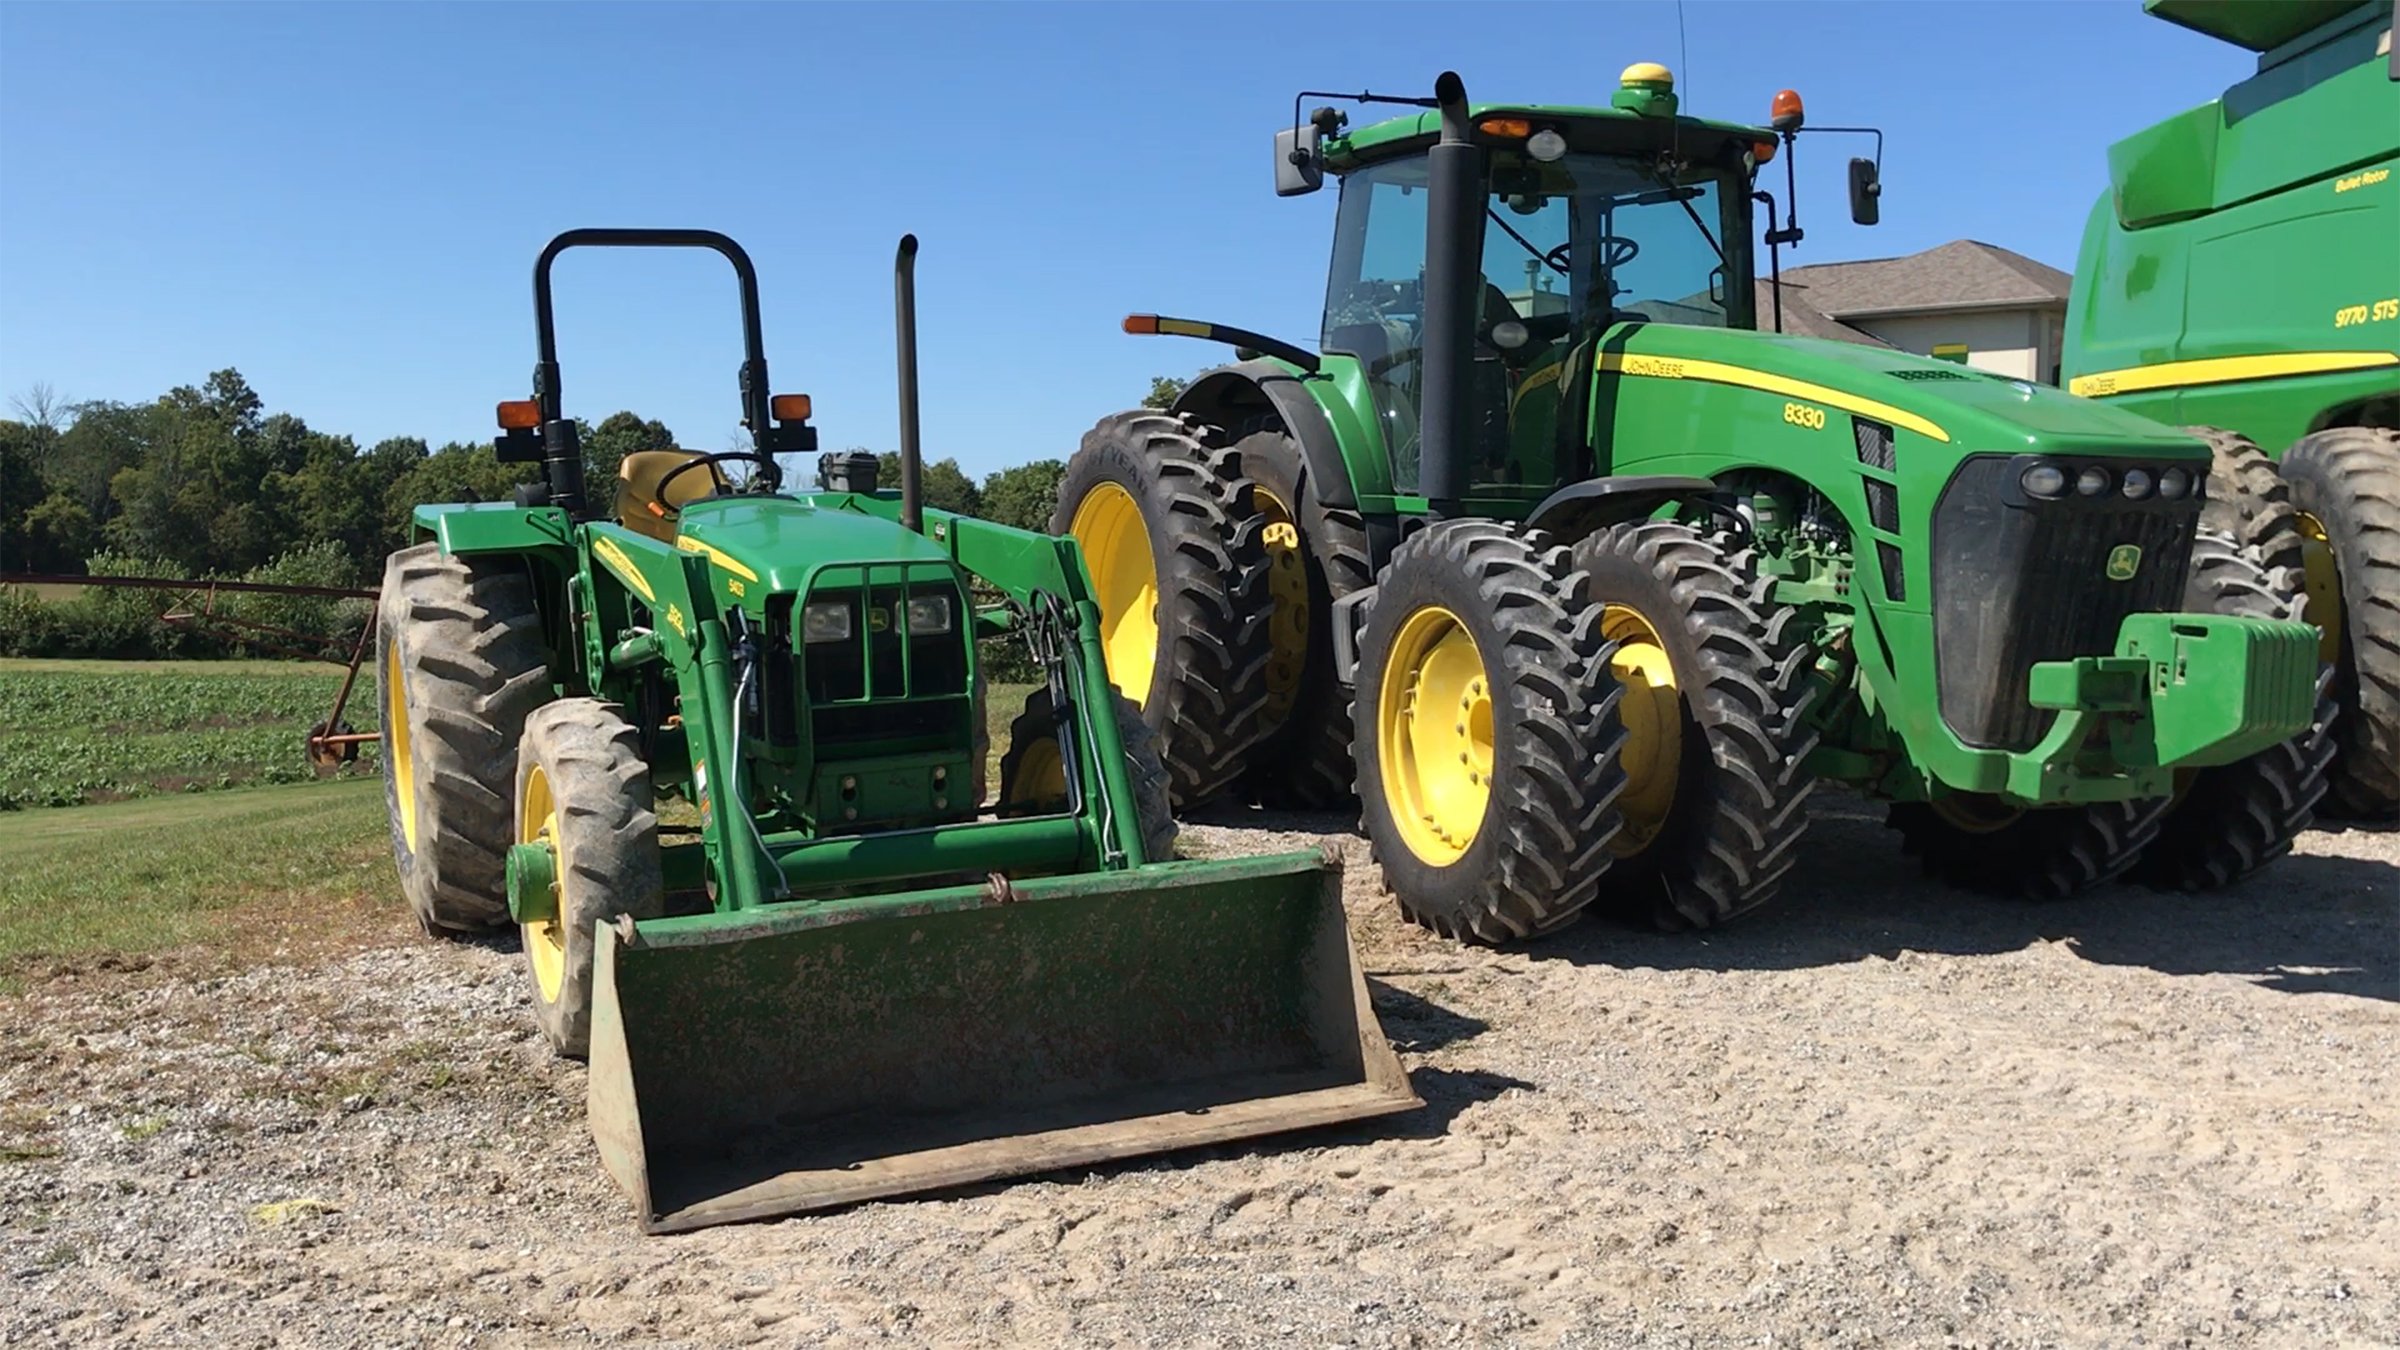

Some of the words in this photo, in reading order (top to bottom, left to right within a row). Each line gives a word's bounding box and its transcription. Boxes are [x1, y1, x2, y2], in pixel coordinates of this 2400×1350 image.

[2361, 169, 2390, 186] Rotor
[2335, 304, 2368, 328] 9770
[2372, 298, 2399, 321] STS
[1652, 360, 1684, 376] DEERE
[1784, 402, 1825, 431] 8330
